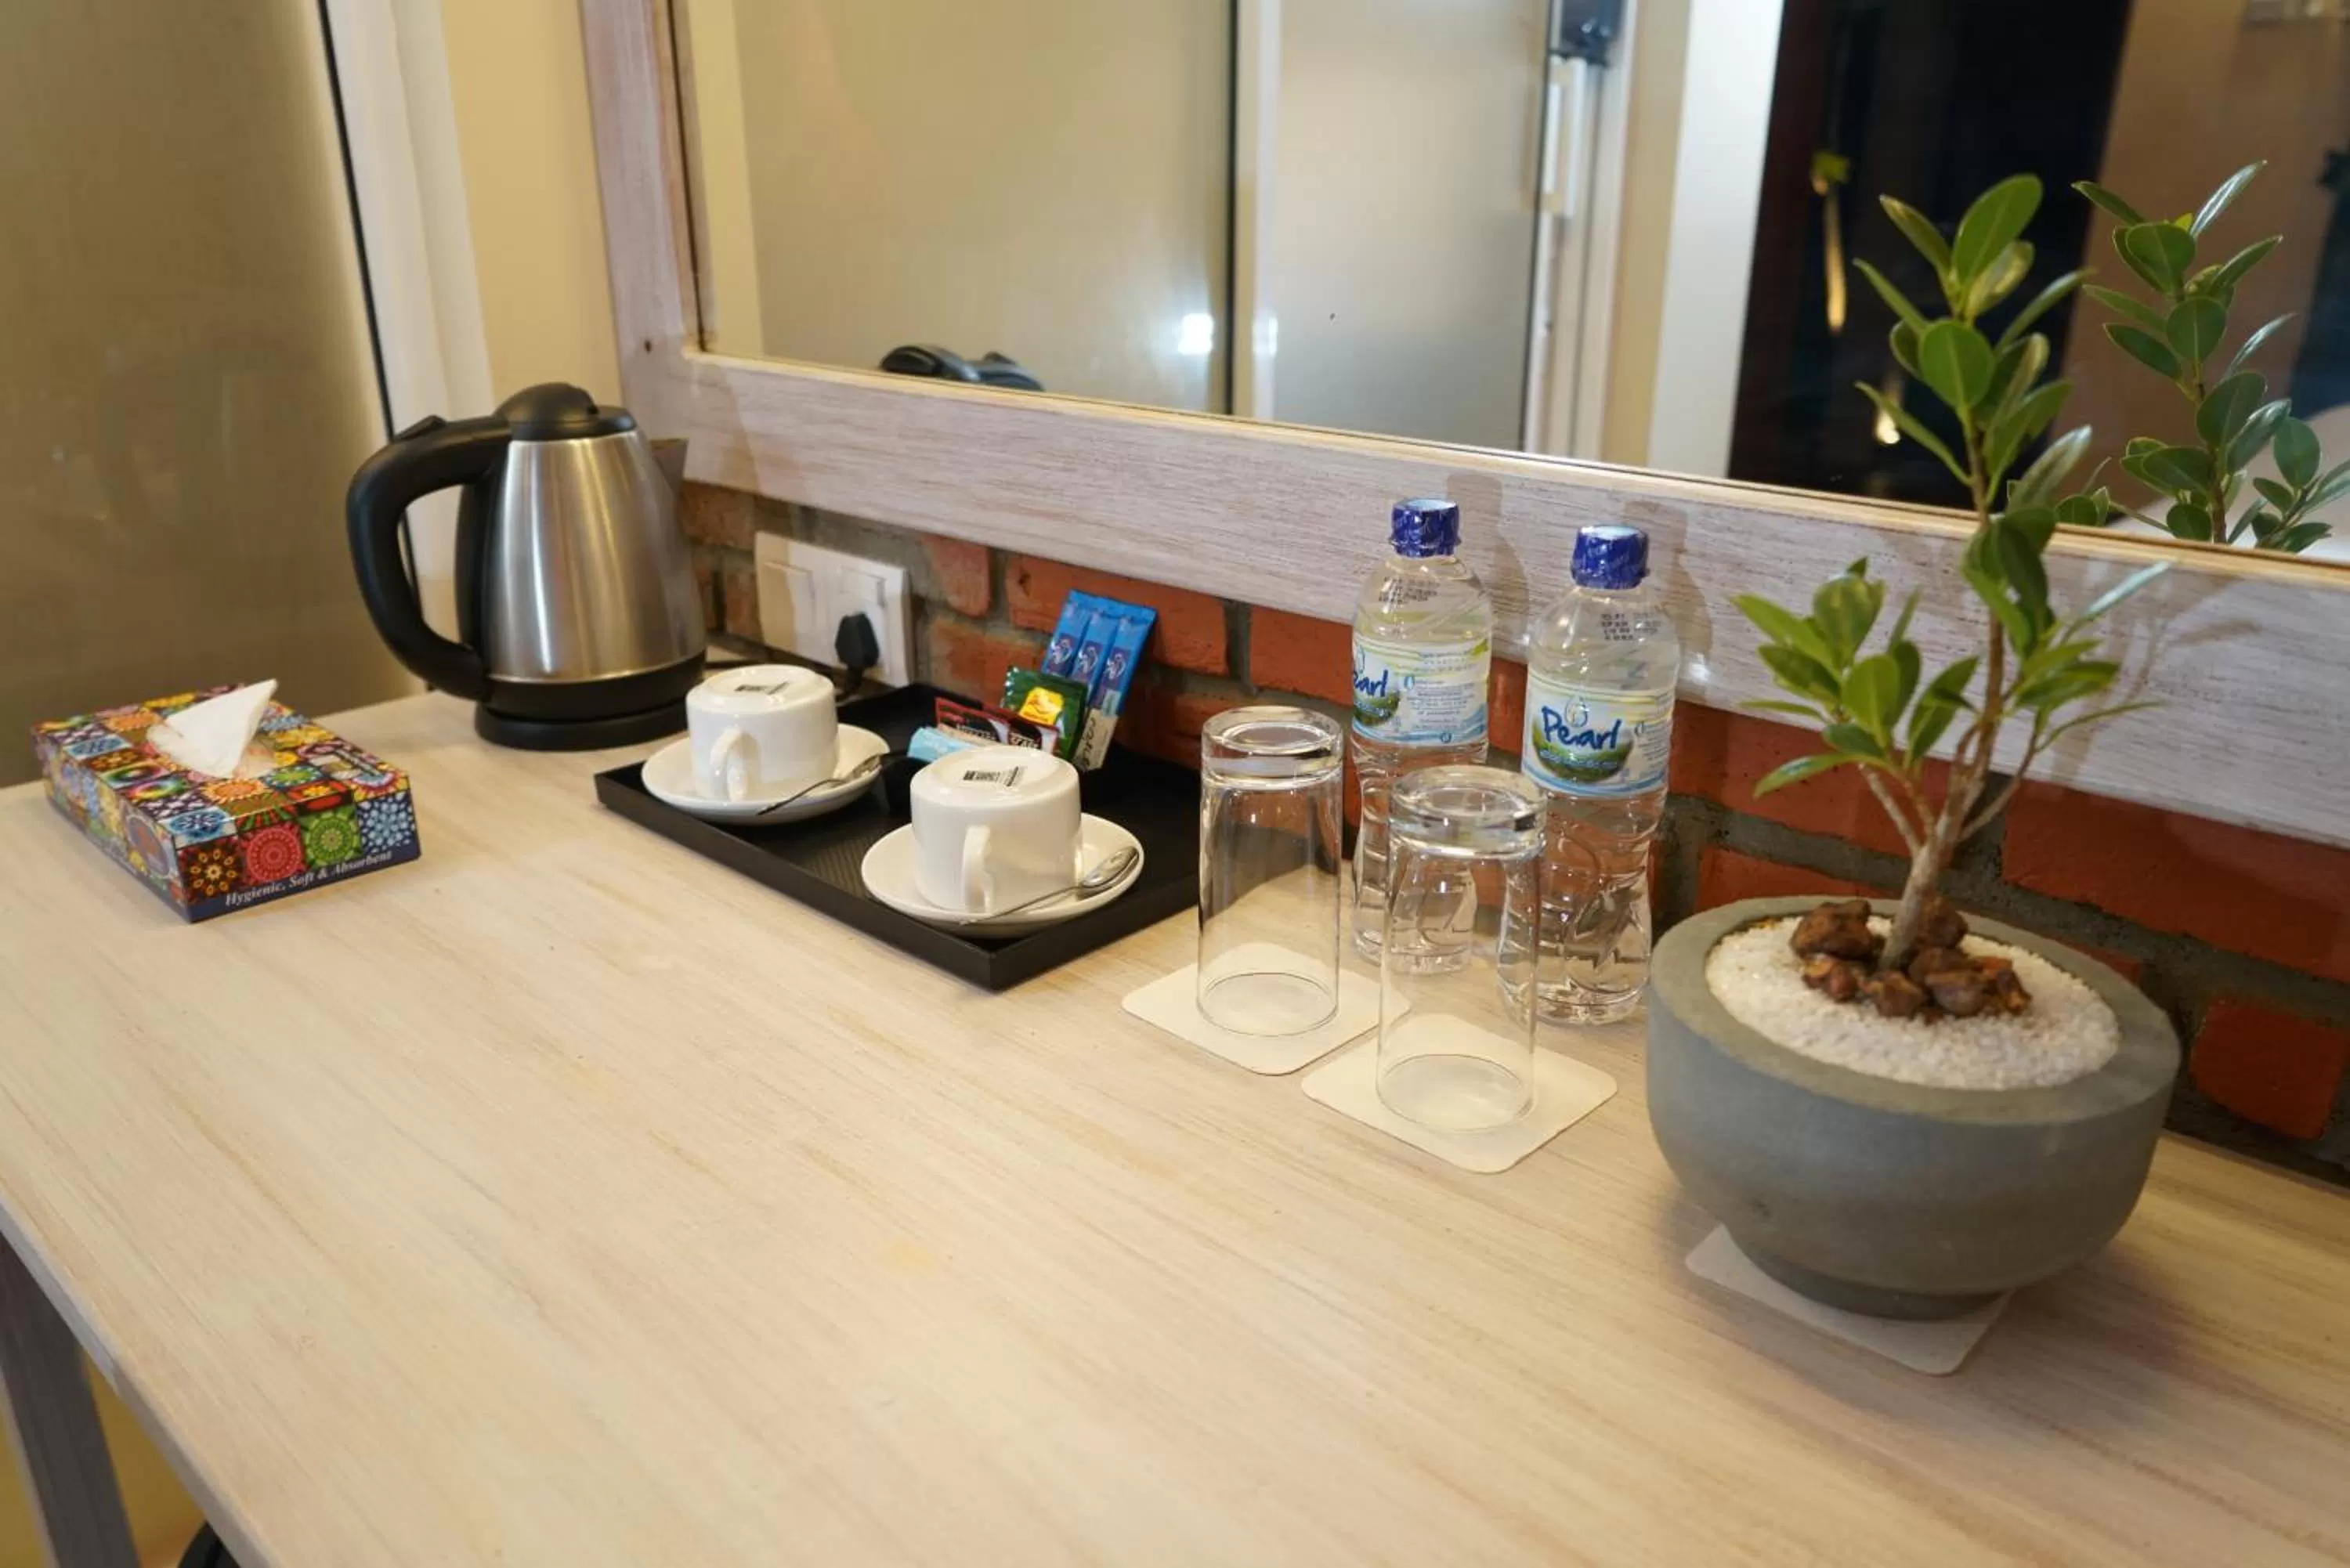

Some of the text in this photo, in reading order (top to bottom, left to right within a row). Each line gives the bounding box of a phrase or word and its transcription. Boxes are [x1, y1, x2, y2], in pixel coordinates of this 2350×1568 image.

[1542, 706, 1622, 750] Pearl
[289, 871, 313, 889] Soft
[317, 868, 328, 880] &
